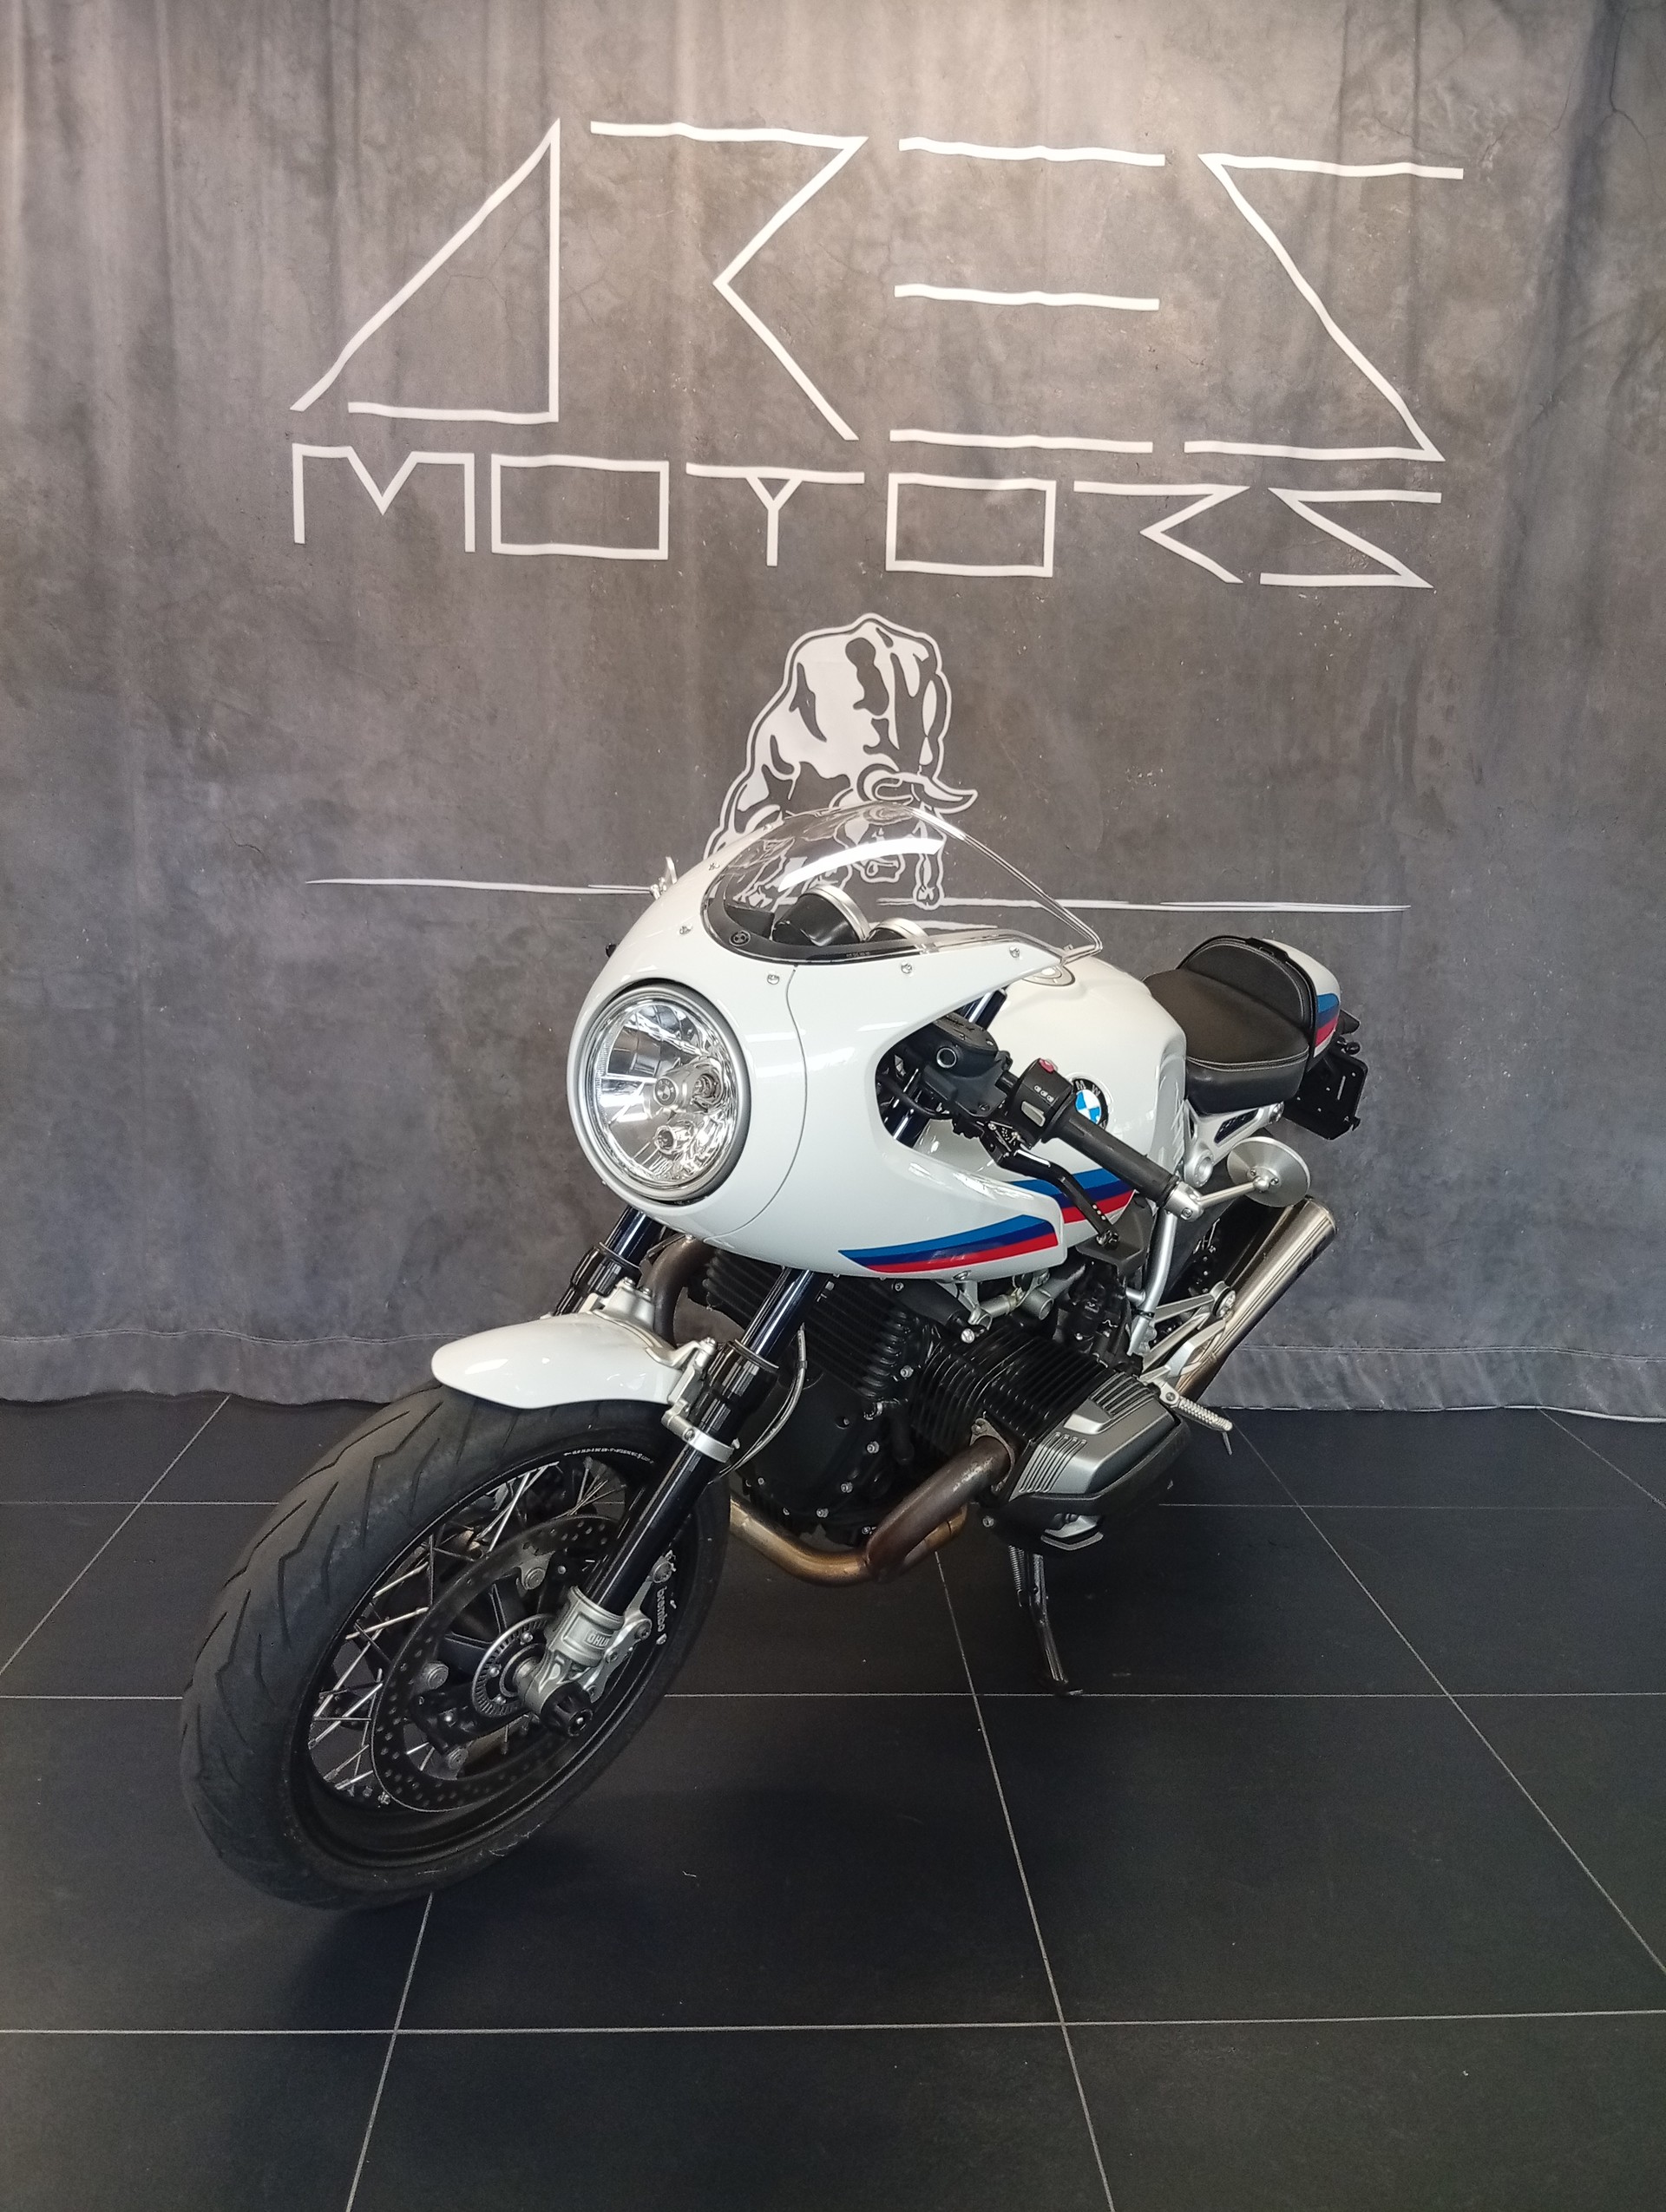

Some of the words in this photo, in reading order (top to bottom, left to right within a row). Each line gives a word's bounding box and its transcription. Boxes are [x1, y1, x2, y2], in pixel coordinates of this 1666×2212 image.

[290, 118, 1465, 461] ARES
[292, 442, 1442, 589] MOTORS
[657, 1586, 667, 1632] brembo
